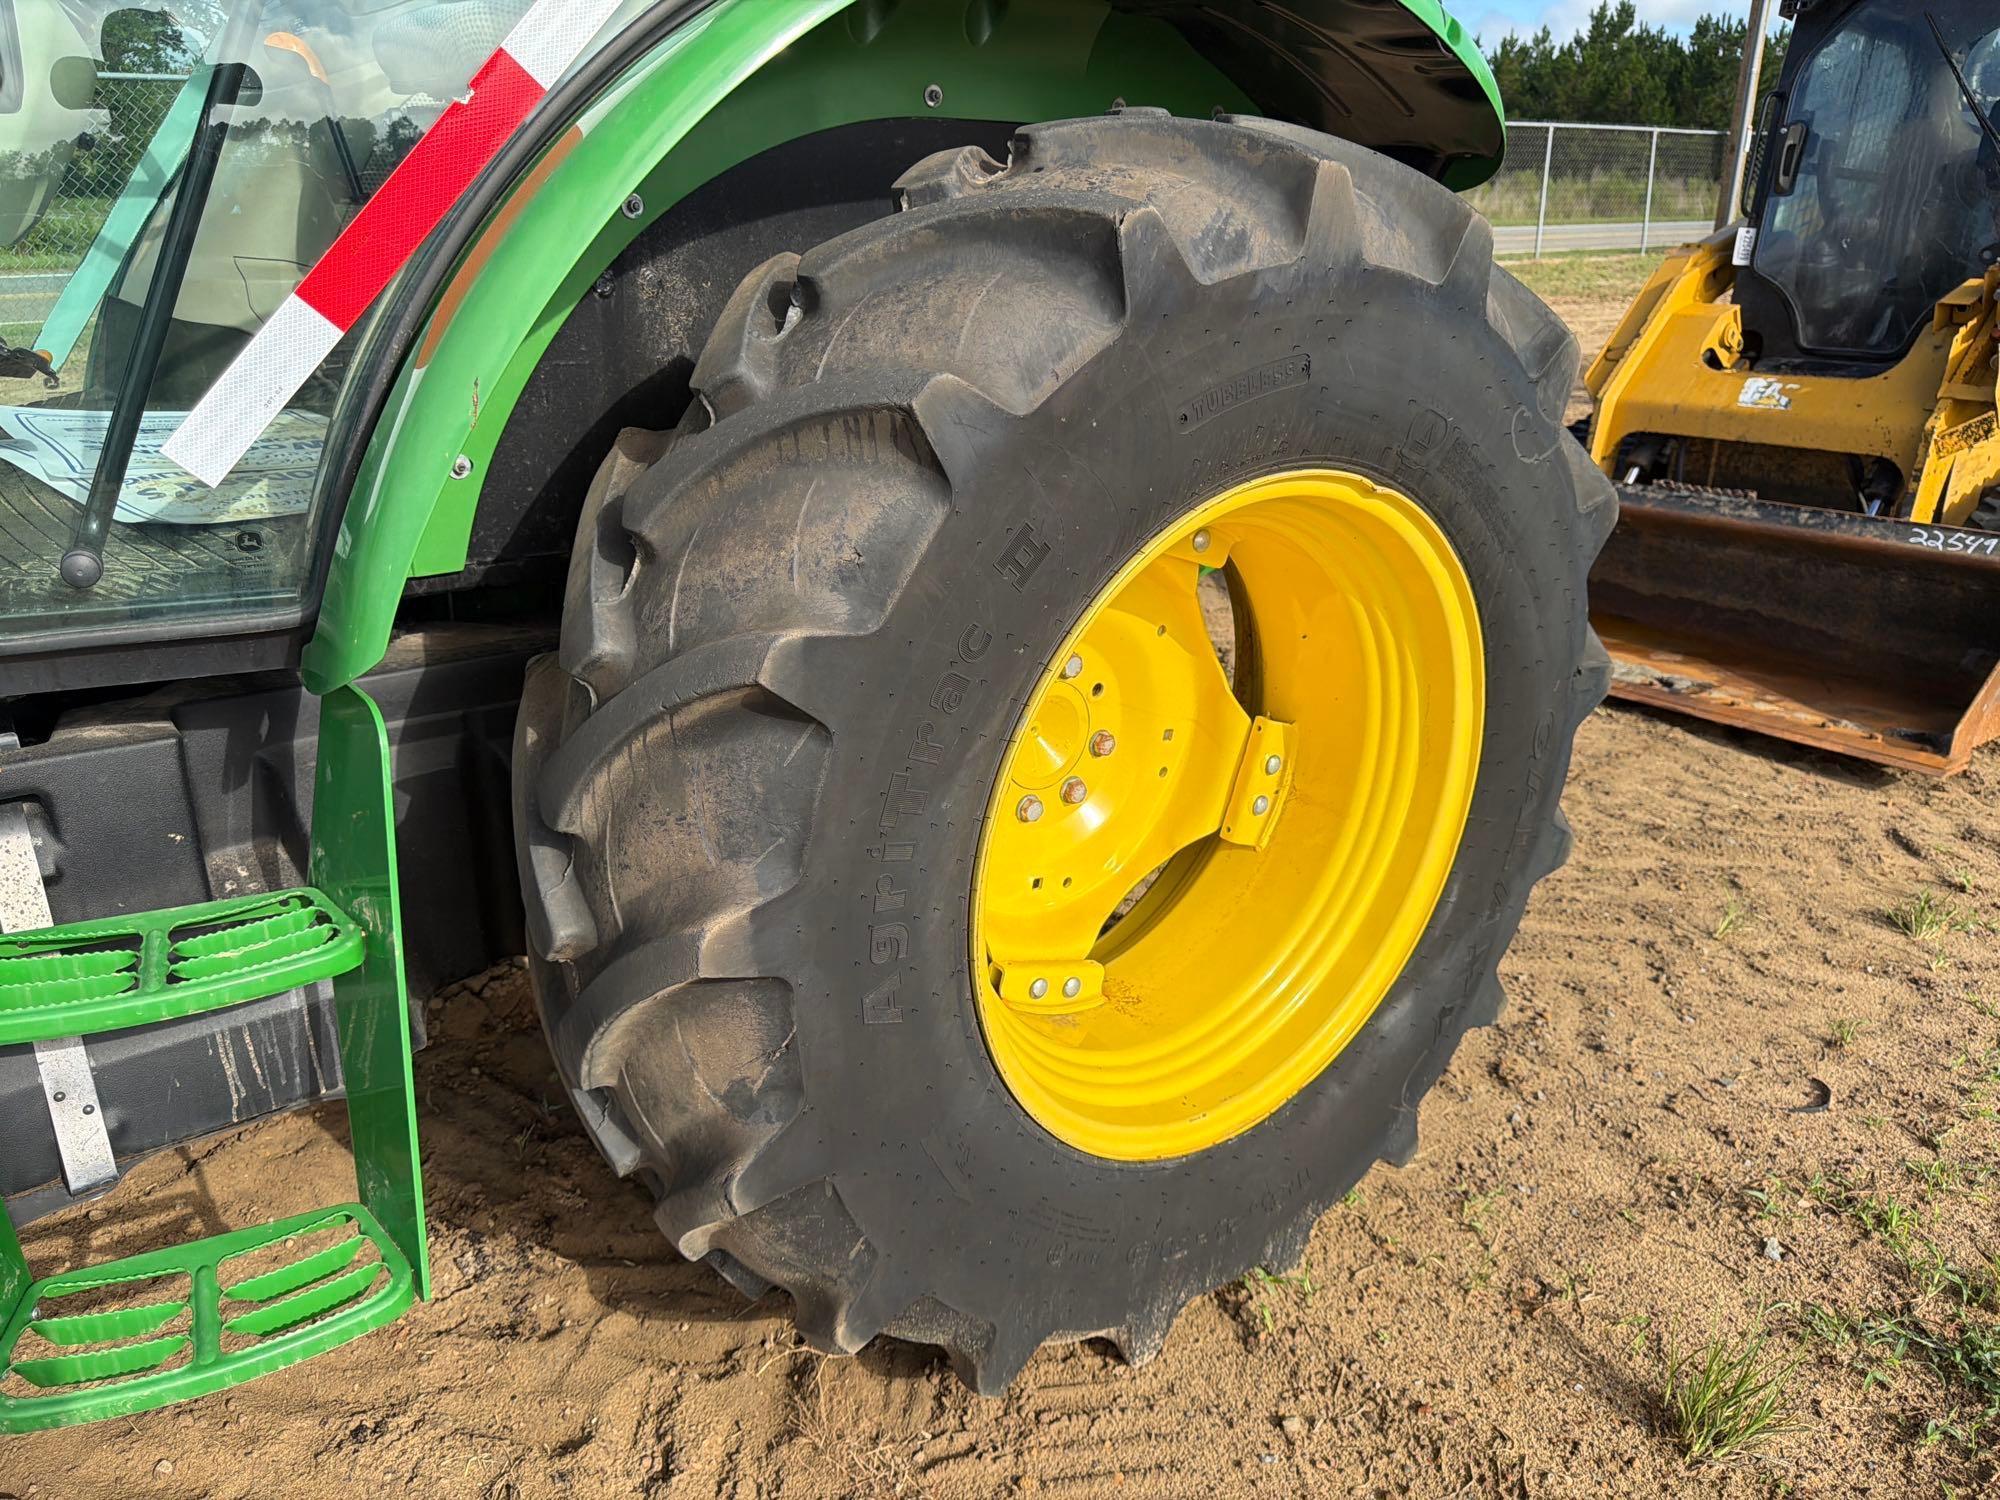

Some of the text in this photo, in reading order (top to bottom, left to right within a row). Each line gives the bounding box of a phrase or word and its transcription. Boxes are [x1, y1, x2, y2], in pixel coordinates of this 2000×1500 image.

[1190, 359, 1298, 421] TUBELESS
[861, 520, 1053, 1025] AgriTrac II
